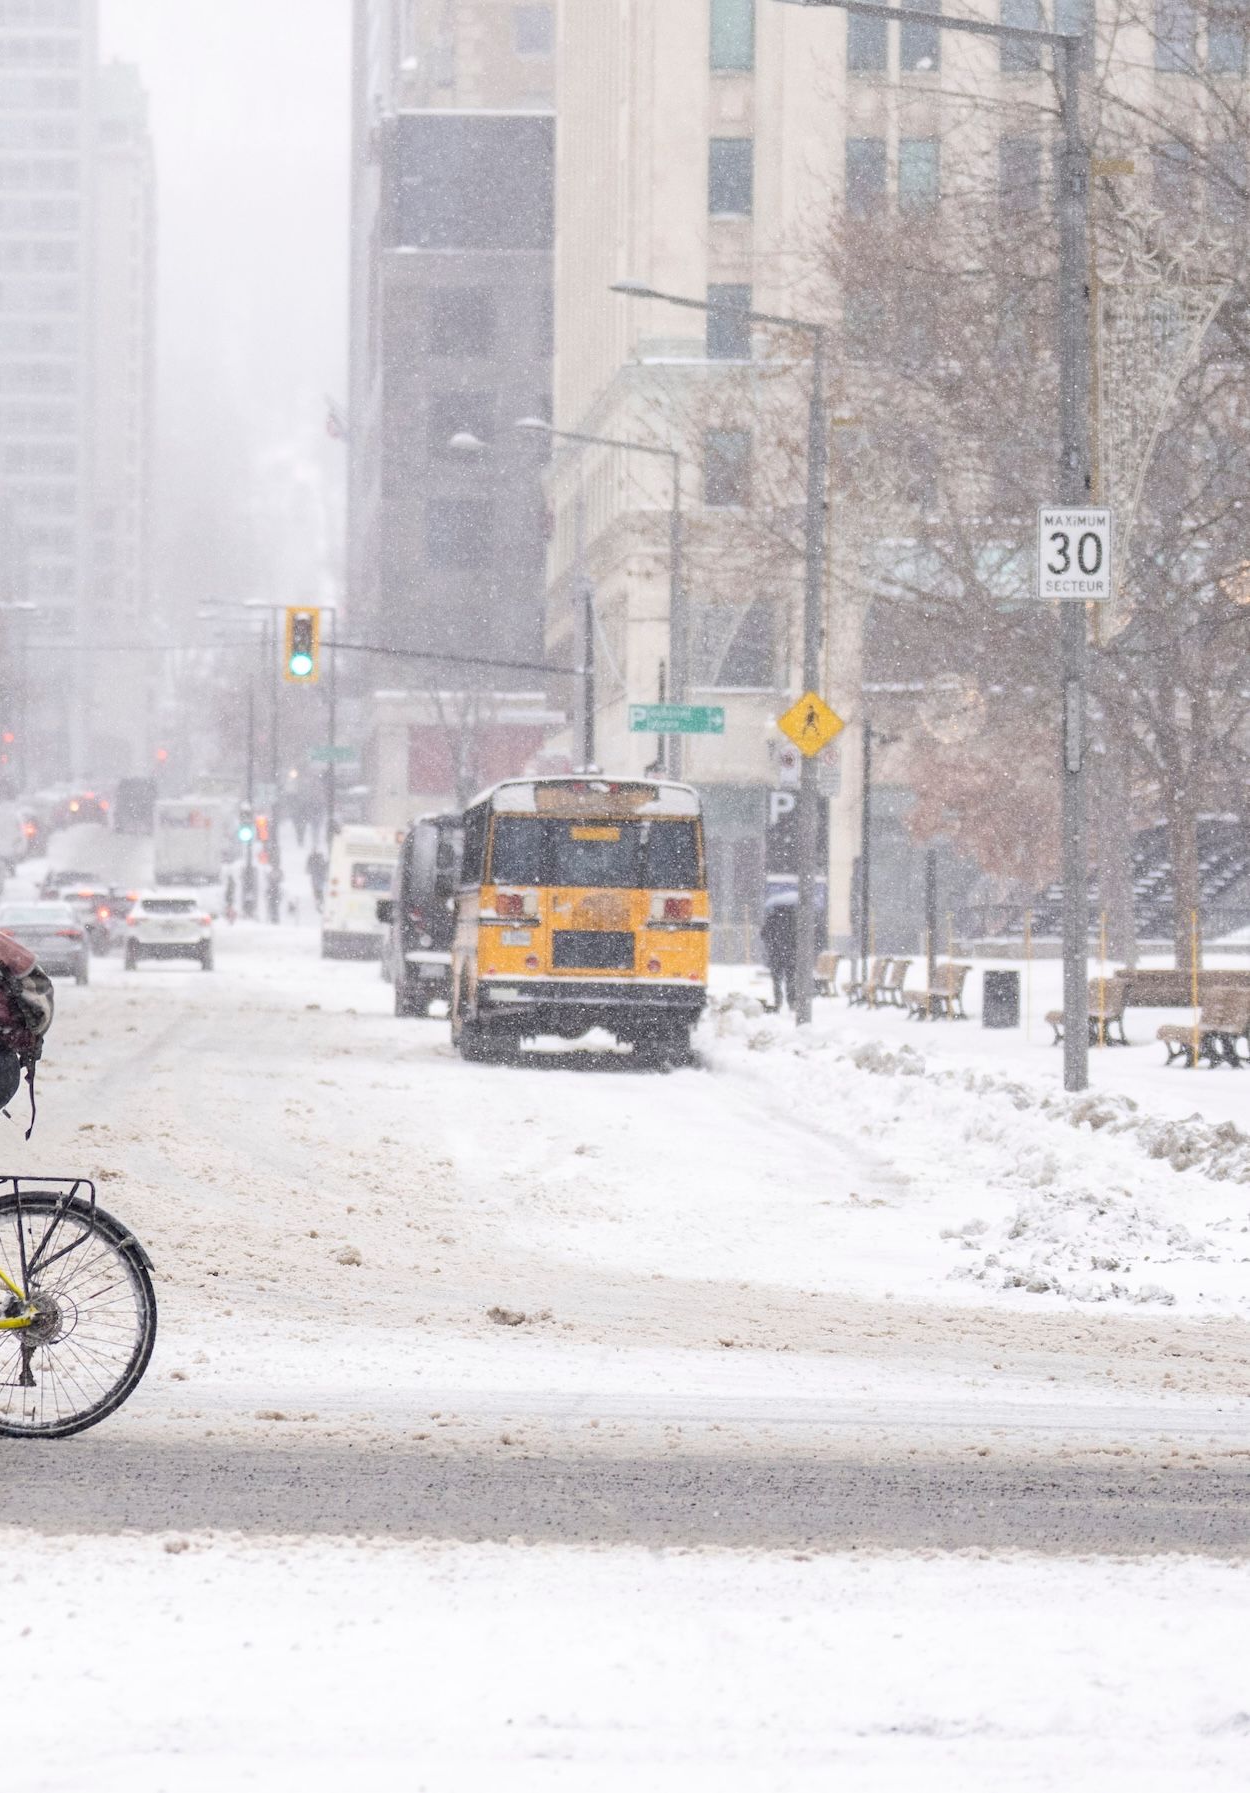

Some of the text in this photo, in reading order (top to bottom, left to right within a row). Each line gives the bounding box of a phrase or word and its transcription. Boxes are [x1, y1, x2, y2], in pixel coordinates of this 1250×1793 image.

[1044, 515, 1106, 527] MAXIMUM
[1047, 531, 1102, 575] 30
[1045, 580, 1104, 592] SECTEUR
[630, 706, 646, 732] P
[770, 792, 795, 824] P
